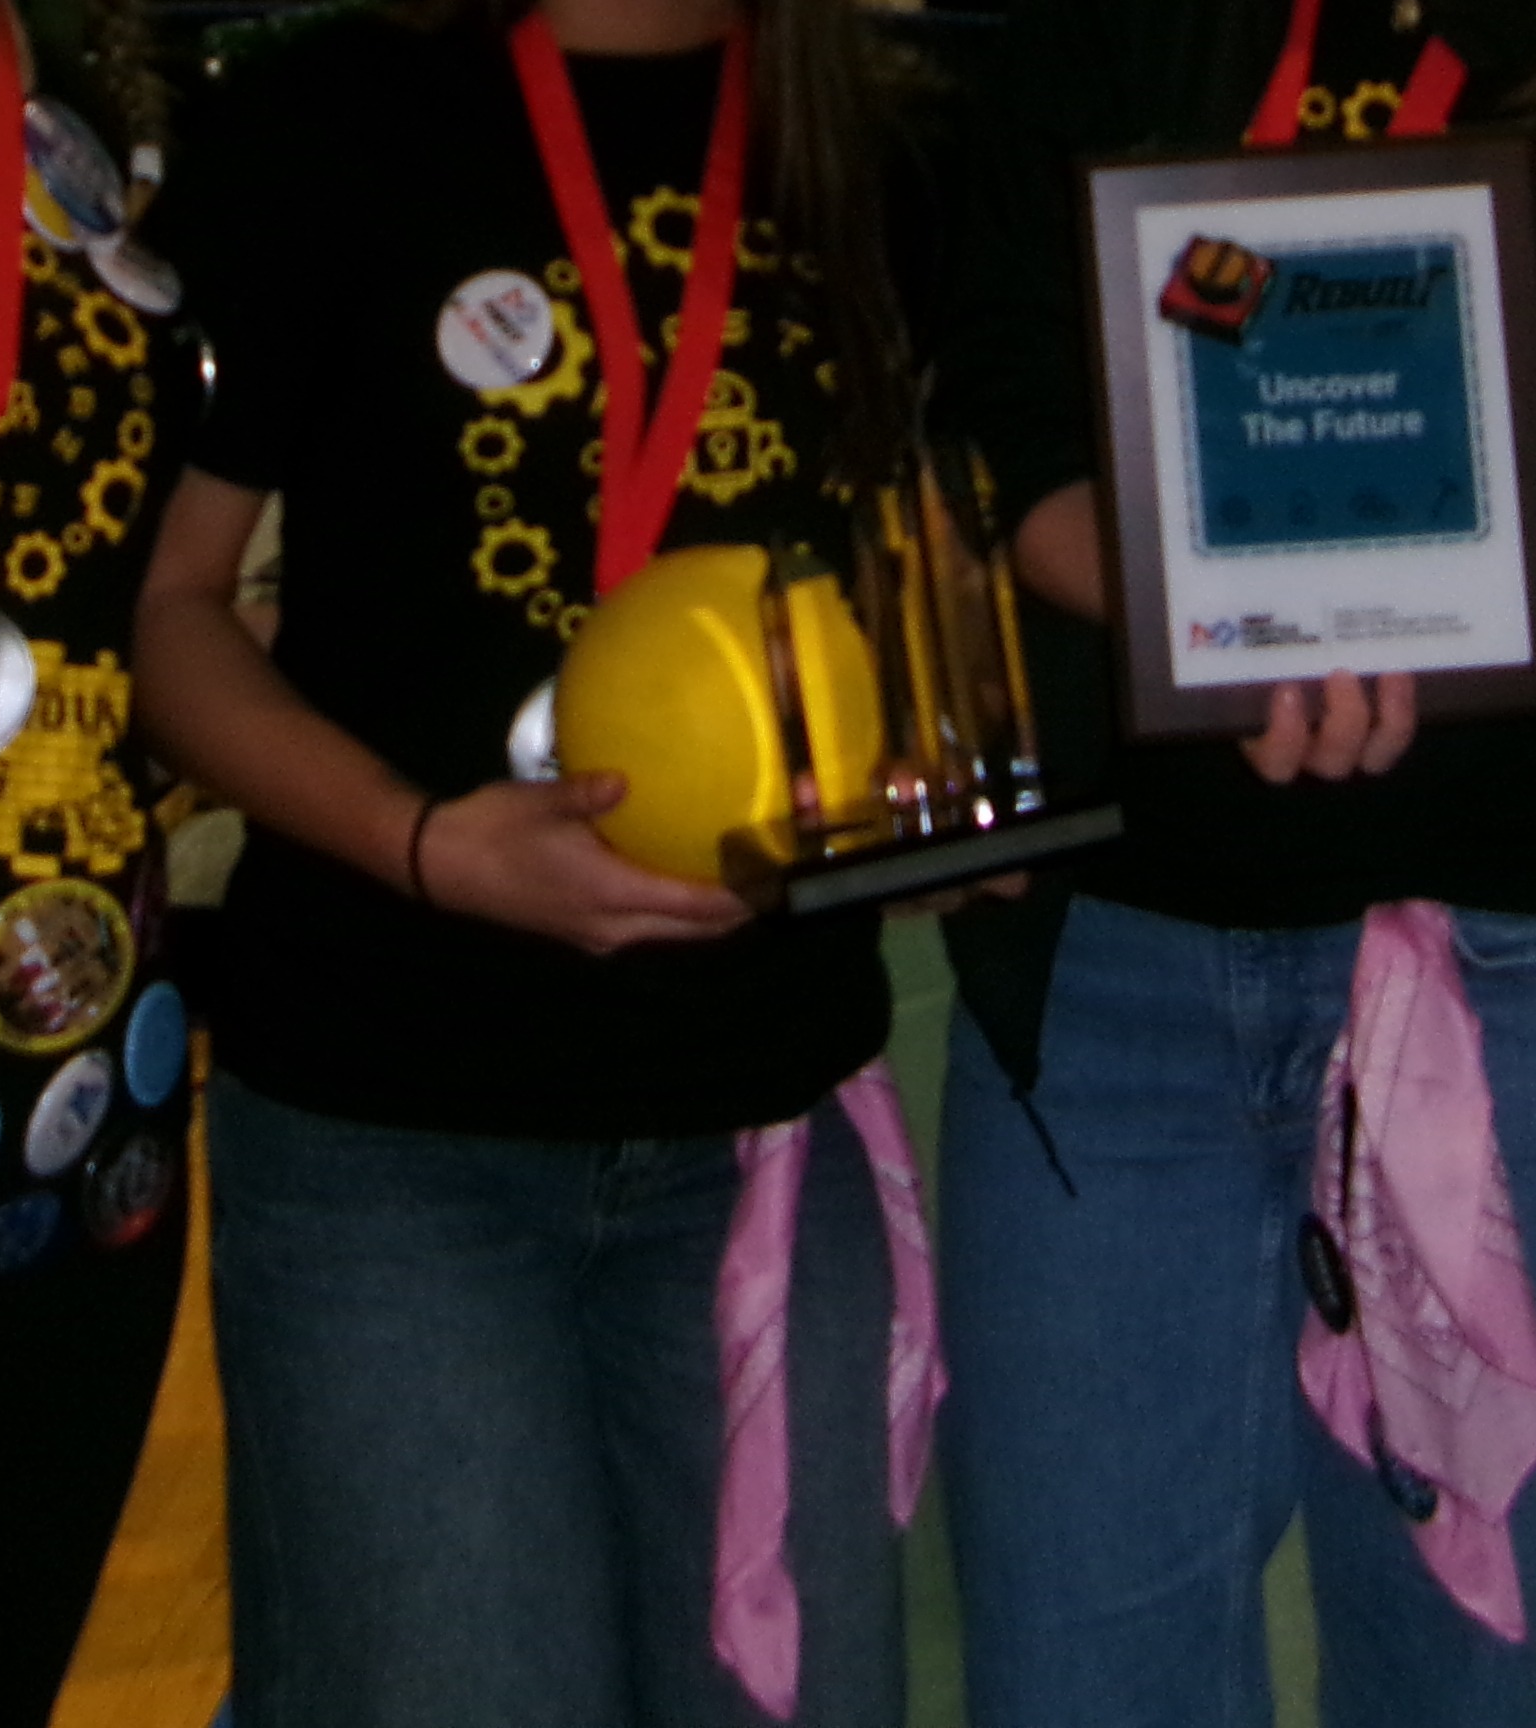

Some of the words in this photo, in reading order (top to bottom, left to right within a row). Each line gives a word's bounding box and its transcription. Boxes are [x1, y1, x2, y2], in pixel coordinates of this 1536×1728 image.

[1258, 371, 1399, 404] Uncover
[1241, 411, 1305, 446] The
[1312, 409, 1425, 442] Future
[38, 685, 122, 740] OUR
